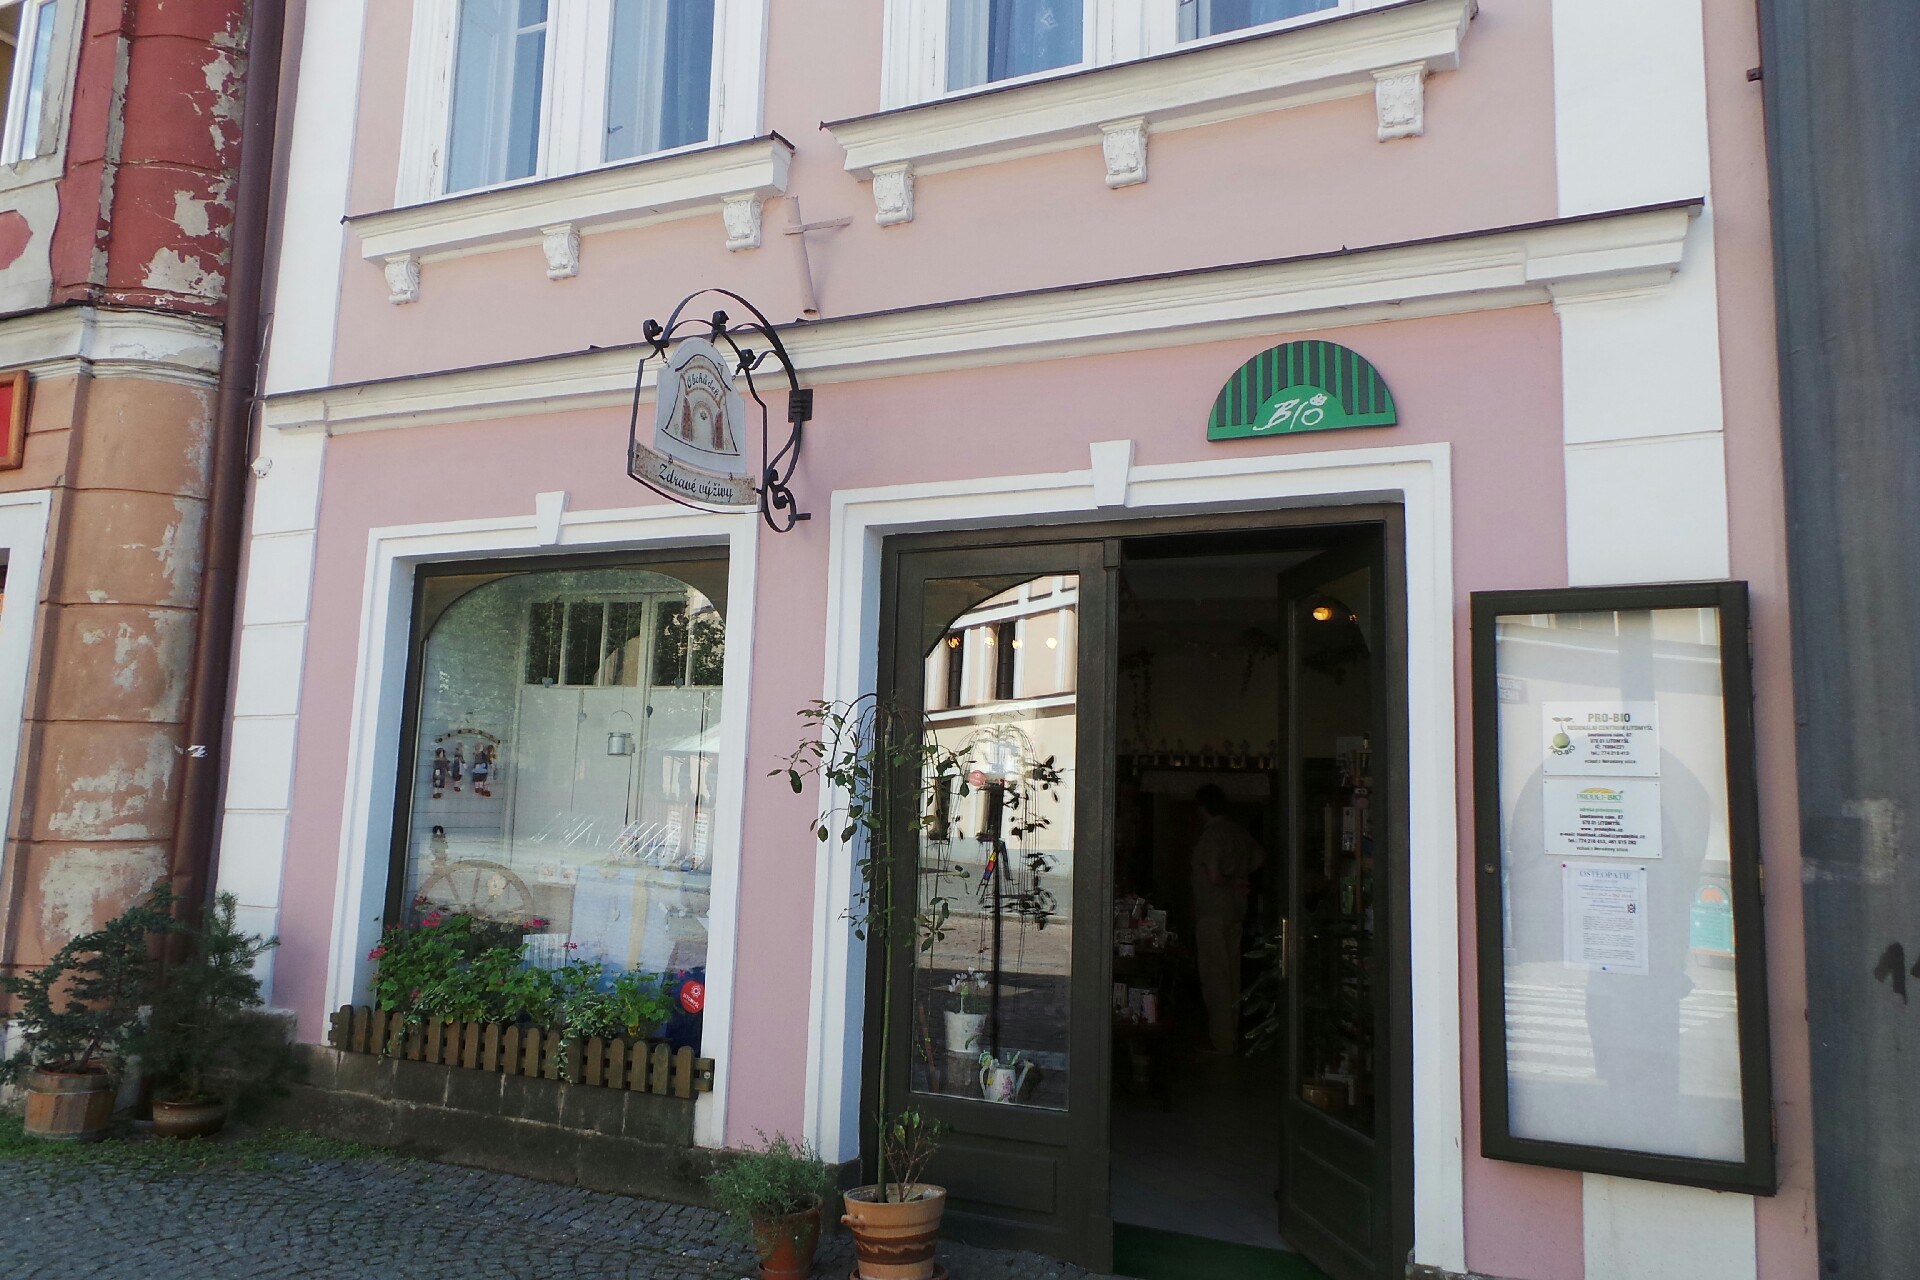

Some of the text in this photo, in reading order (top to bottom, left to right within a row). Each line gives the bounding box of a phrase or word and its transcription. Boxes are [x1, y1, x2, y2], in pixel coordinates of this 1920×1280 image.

[658, 463, 734, 503] Zdravé výživy
[1588, 713, 1631, 723] PRO-BIO
[1579, 870, 1632, 880] OSTEOPATIE
